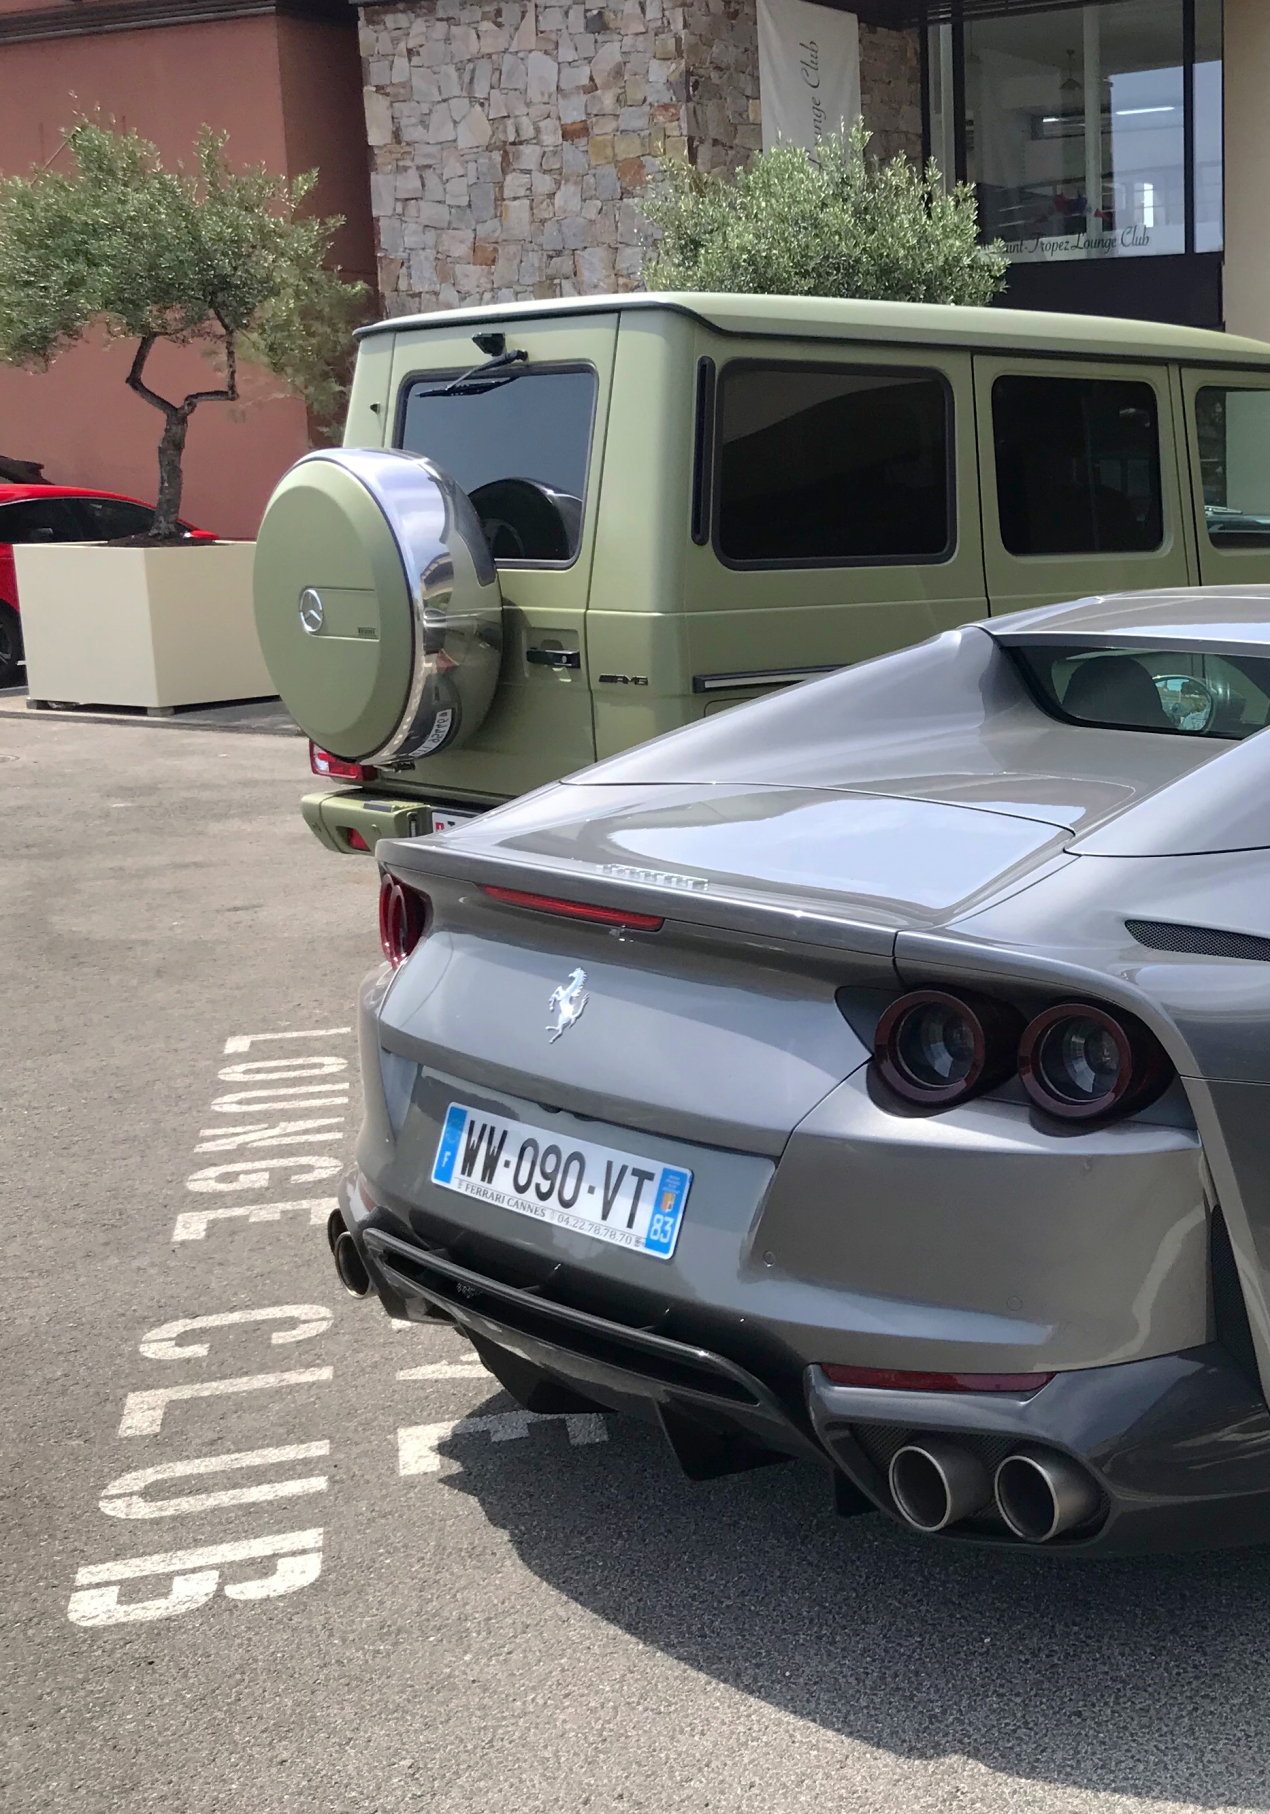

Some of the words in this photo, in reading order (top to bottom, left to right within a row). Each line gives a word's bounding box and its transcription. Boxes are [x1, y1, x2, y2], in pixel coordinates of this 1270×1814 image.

[799, 40, 821, 89] Club
[805, 96, 827, 174] Lunge
[994, 232, 1070, 256] aint-Tropez
[1071, 232, 1117, 255] Lounge
[1121, 225, 1150, 248] Club
[171, 1027, 351, 1242] LOUNGE
[441, 1151, 451, 1168] F
[460, 1120, 656, 1230] WW-090-VT
[464, 1183, 504, 1204] FERRARI
[507, 1198, 547, 1218] CANNES
[650, 1214, 674, 1243] 83
[67, 1304, 334, 1627] CLUB
